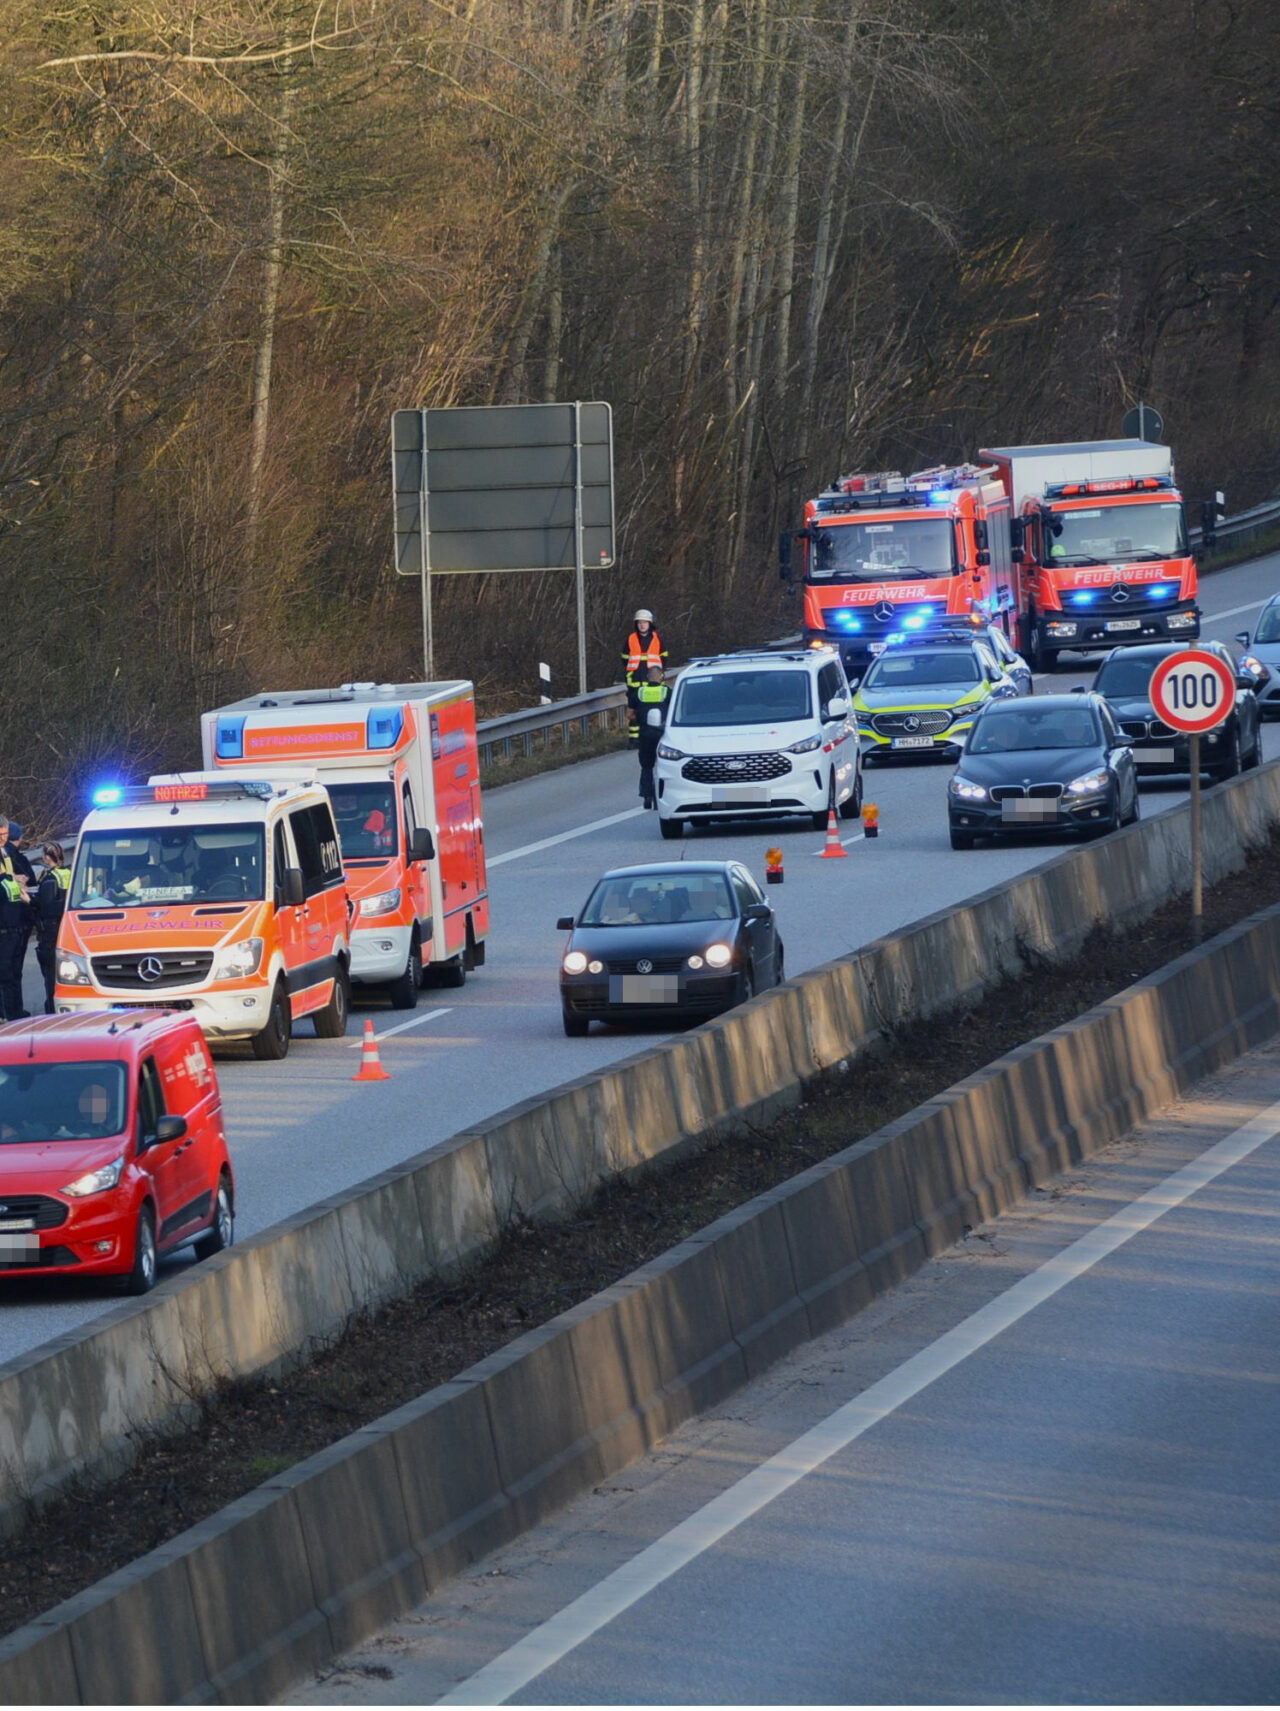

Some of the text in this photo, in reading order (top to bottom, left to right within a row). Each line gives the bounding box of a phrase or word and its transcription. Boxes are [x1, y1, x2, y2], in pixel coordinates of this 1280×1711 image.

[1074, 568, 1164, 585] FEUERWEHR
[842, 587, 926, 602] FEUERWEHR
[1168, 673, 1217, 709] 100
[250, 731, 359, 748] RETTUNGSDIENST
[154, 784, 208, 801] NOTARZT
[87, 920, 225, 934] FEUERWEHR
